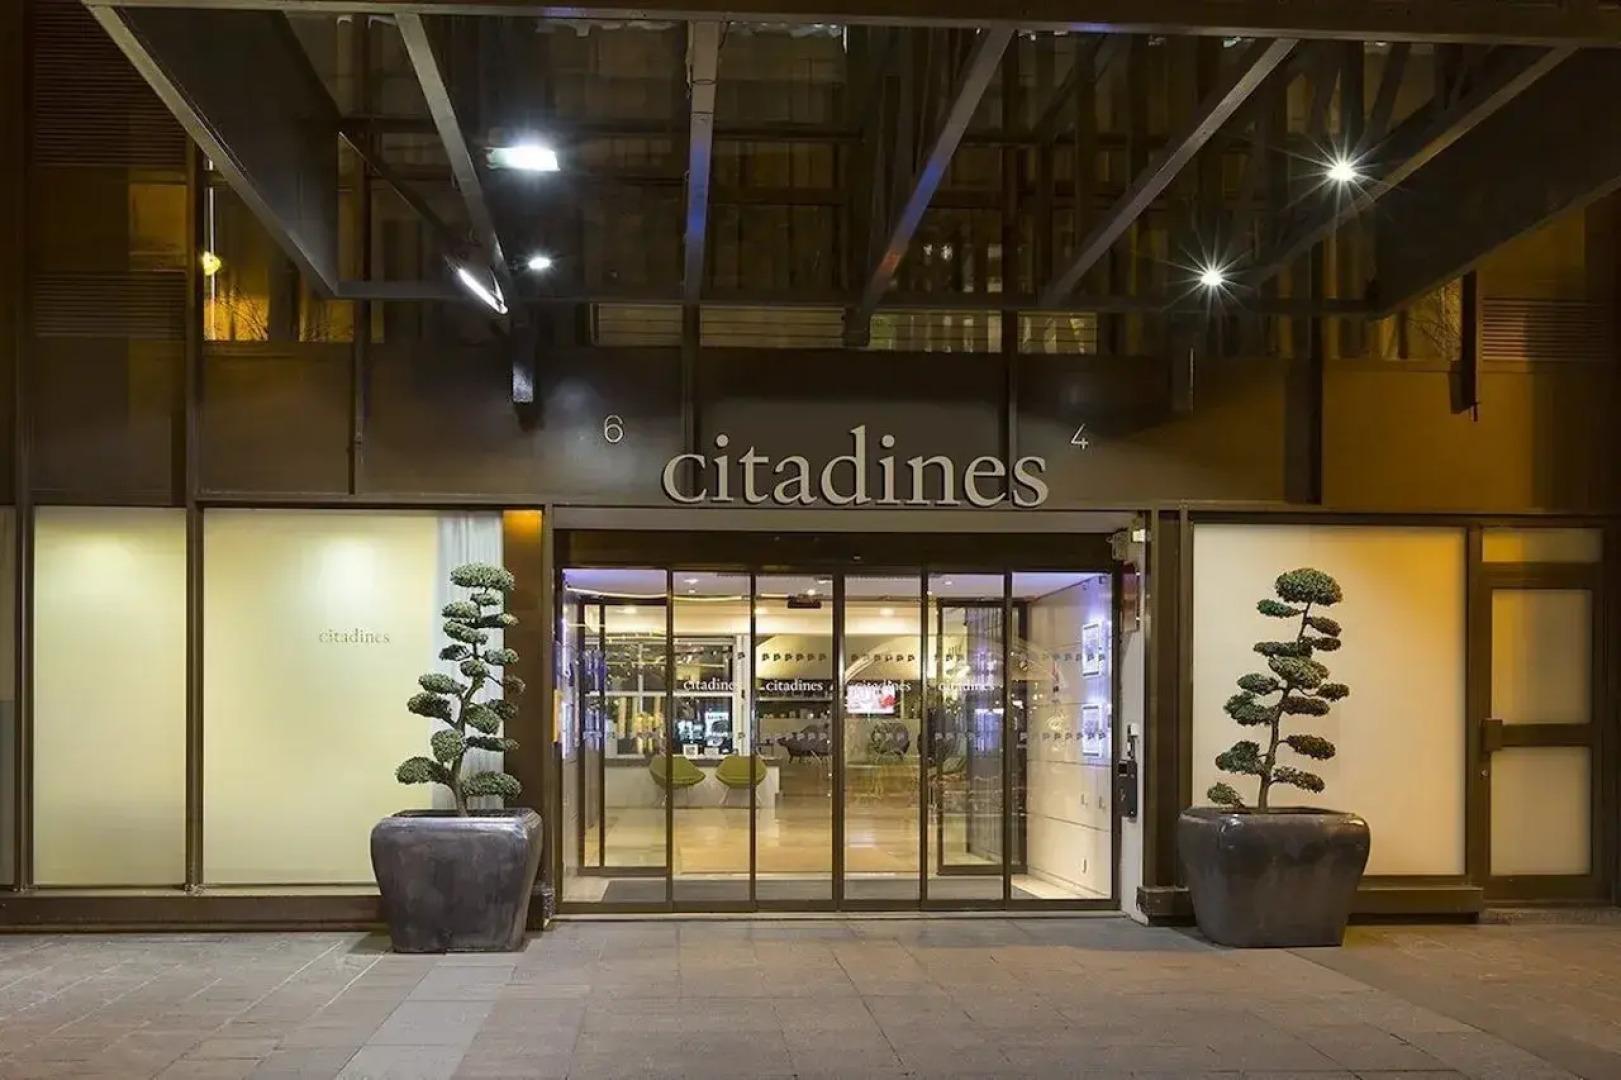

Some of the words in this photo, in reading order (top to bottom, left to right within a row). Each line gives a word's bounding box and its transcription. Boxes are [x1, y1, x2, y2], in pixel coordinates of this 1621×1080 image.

[604, 414, 623, 443] 6
[1071, 423, 1089, 450] 4
[662, 425, 1049, 508] citadines
[319, 627, 391, 643] citadines
[683, 677, 741, 691] citadine
[765, 677, 823, 692] citadines
